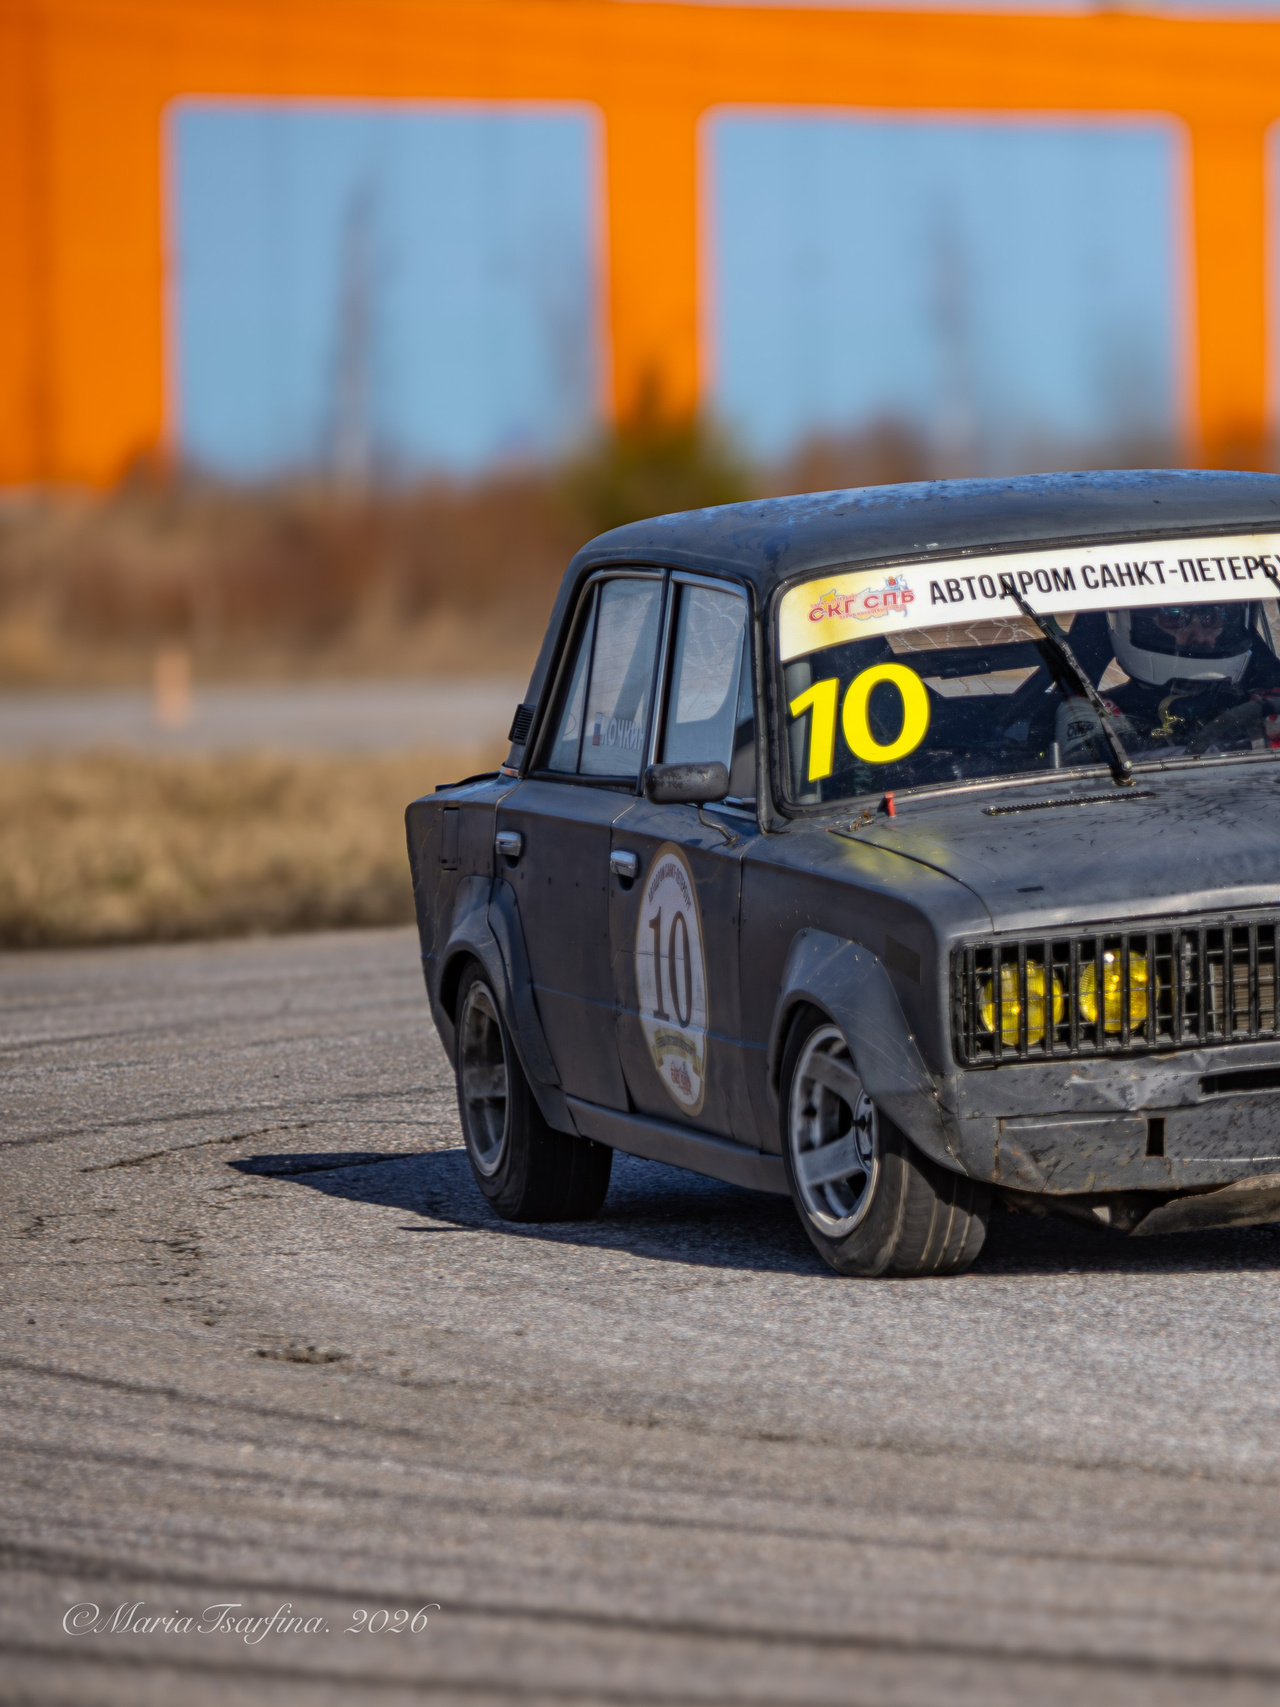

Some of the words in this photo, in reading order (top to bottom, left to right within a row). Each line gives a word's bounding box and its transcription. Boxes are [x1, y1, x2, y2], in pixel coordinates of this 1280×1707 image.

[809, 599, 855, 622] СКГ
[863, 589, 915, 609] СПБ
[929, 566, 1076, 606] АВТОДРОМ
[789, 662, 930, 783] 10
[649, 905, 693, 1029] 10
